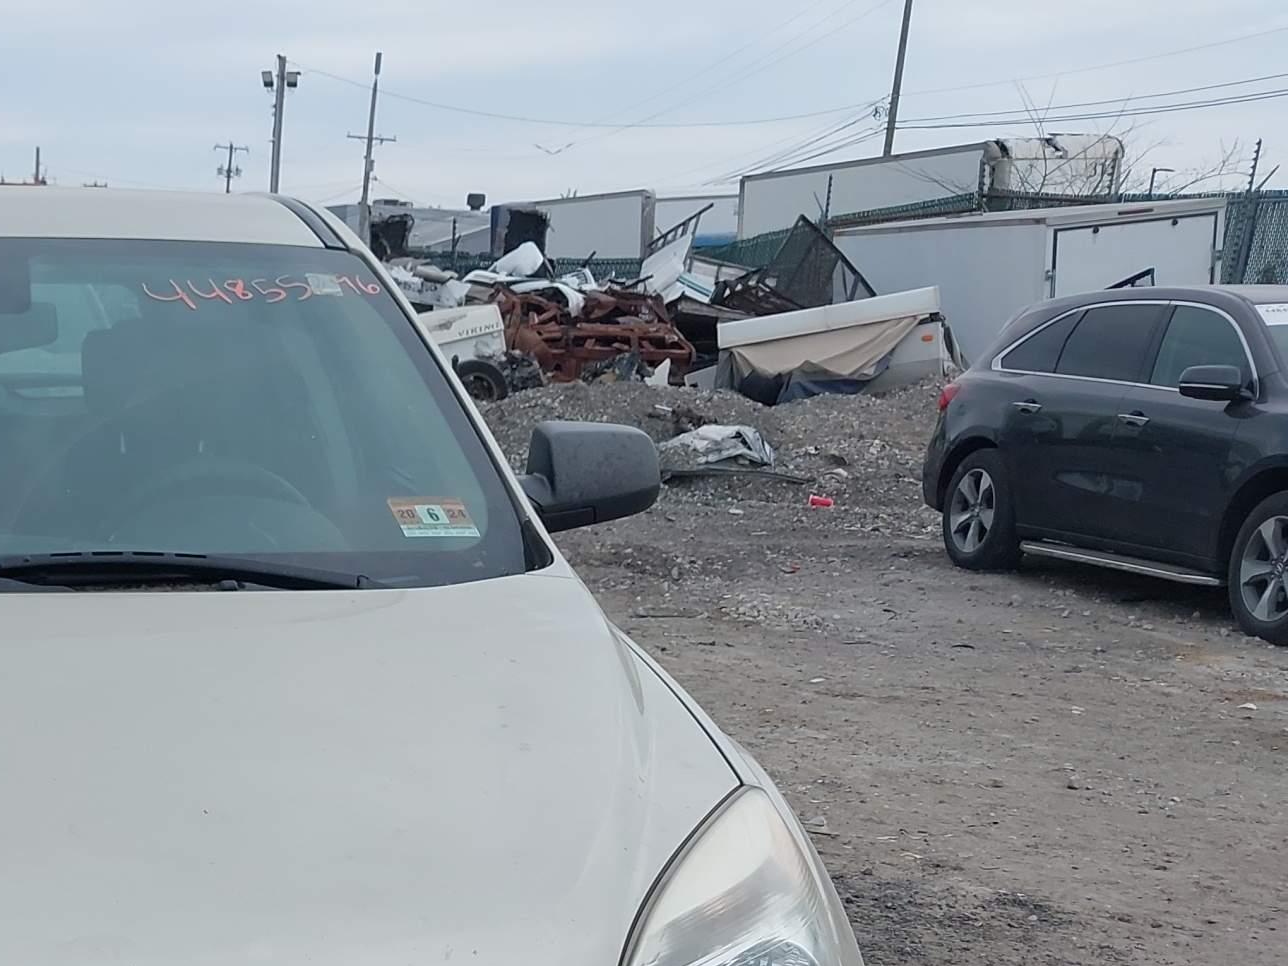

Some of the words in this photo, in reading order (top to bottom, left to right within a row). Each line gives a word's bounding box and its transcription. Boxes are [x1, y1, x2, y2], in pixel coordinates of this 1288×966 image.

[141, 273, 380, 310] 448556
[398, 509, 415, 519] 20
[427, 507, 440, 522] 6
